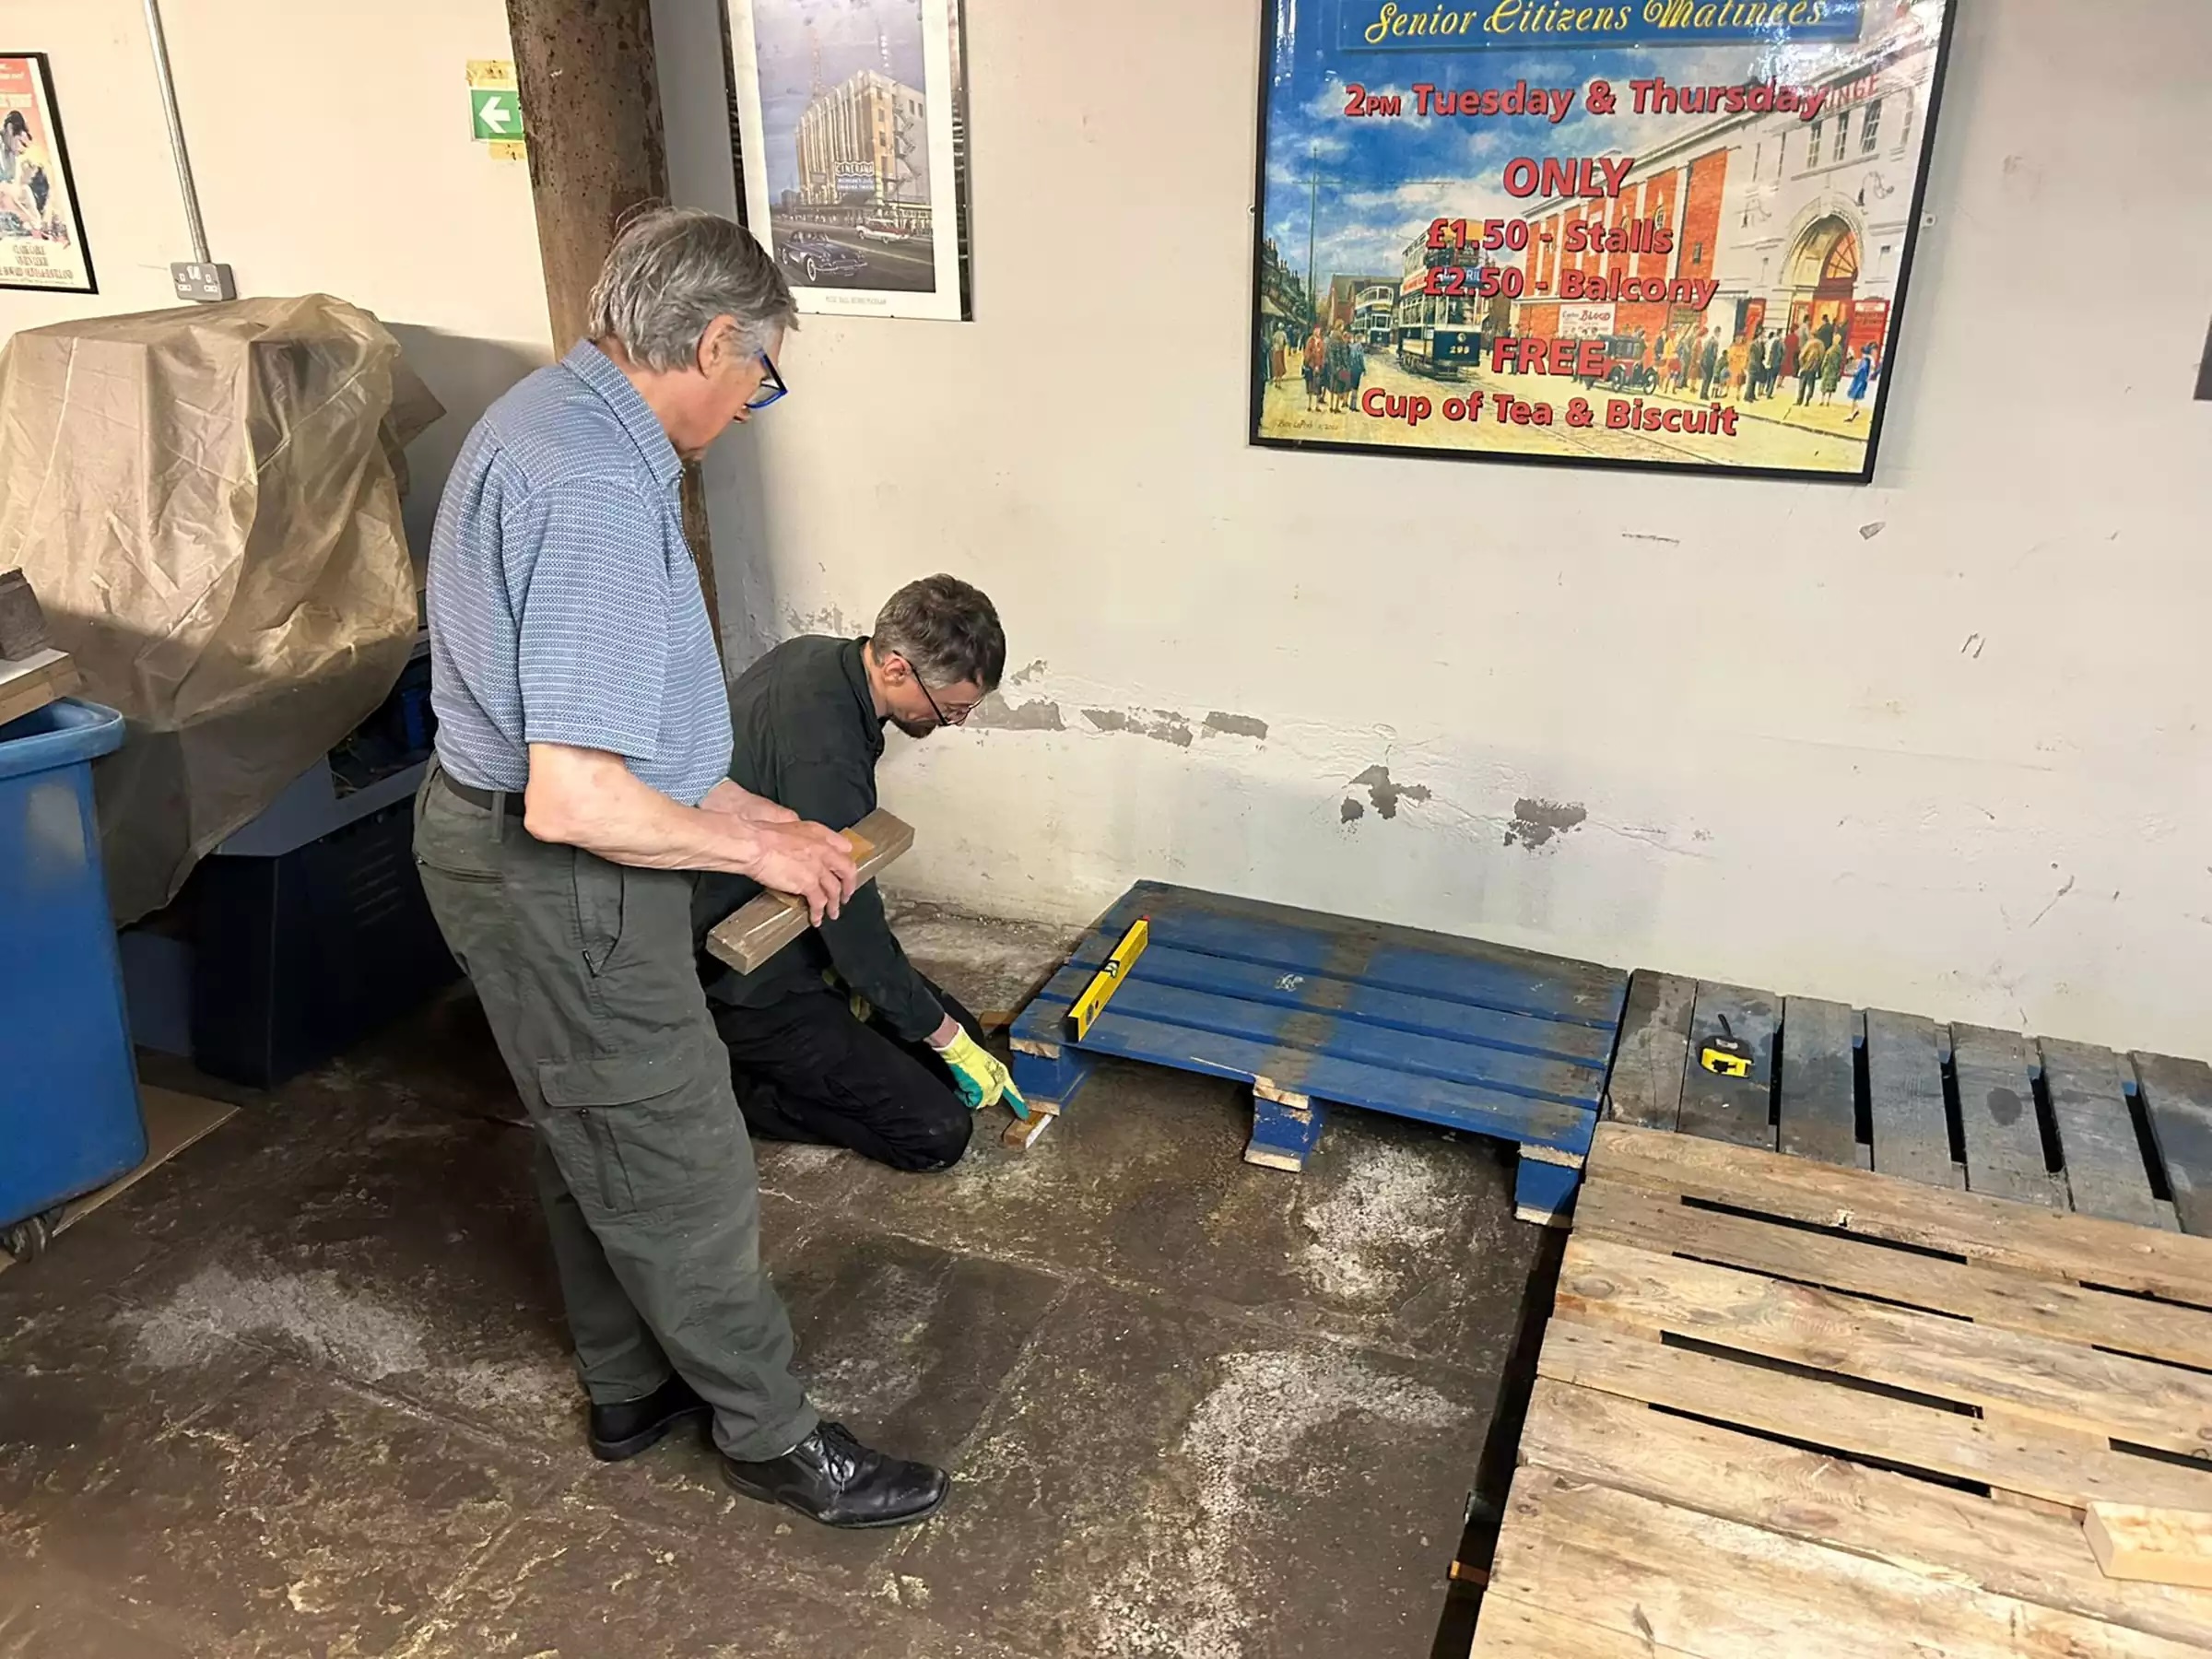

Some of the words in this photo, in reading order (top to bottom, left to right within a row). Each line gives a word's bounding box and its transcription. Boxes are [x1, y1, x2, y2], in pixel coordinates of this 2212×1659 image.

[1364, 2, 1477, 43] Senior
[1483, 0, 1631, 33] Citizens
[1642, 0, 1821, 28] Matinees
[1344, 84, 1401, 116] 2PM
[1412, 79, 1574, 124] Tuesday
[1585, 80, 1616, 114] &
[1630, 76, 1828, 122] Thursday
[1502, 157, 1634, 198] ONLY
[1426, 218, 1529, 251] £1.50
[1564, 218, 1674, 253] Stalls
[1423, 266, 1524, 298] £2.50
[1559, 268, 1720, 312] Balcony
[1491, 335, 1607, 378] FREE
[1361, 387, 1432, 426] Cup
[1441, 390, 1484, 422] of
[1492, 394, 1554, 426] Tea
[1566, 397, 1594, 429] &
[1606, 398, 1739, 436] Biscuit
